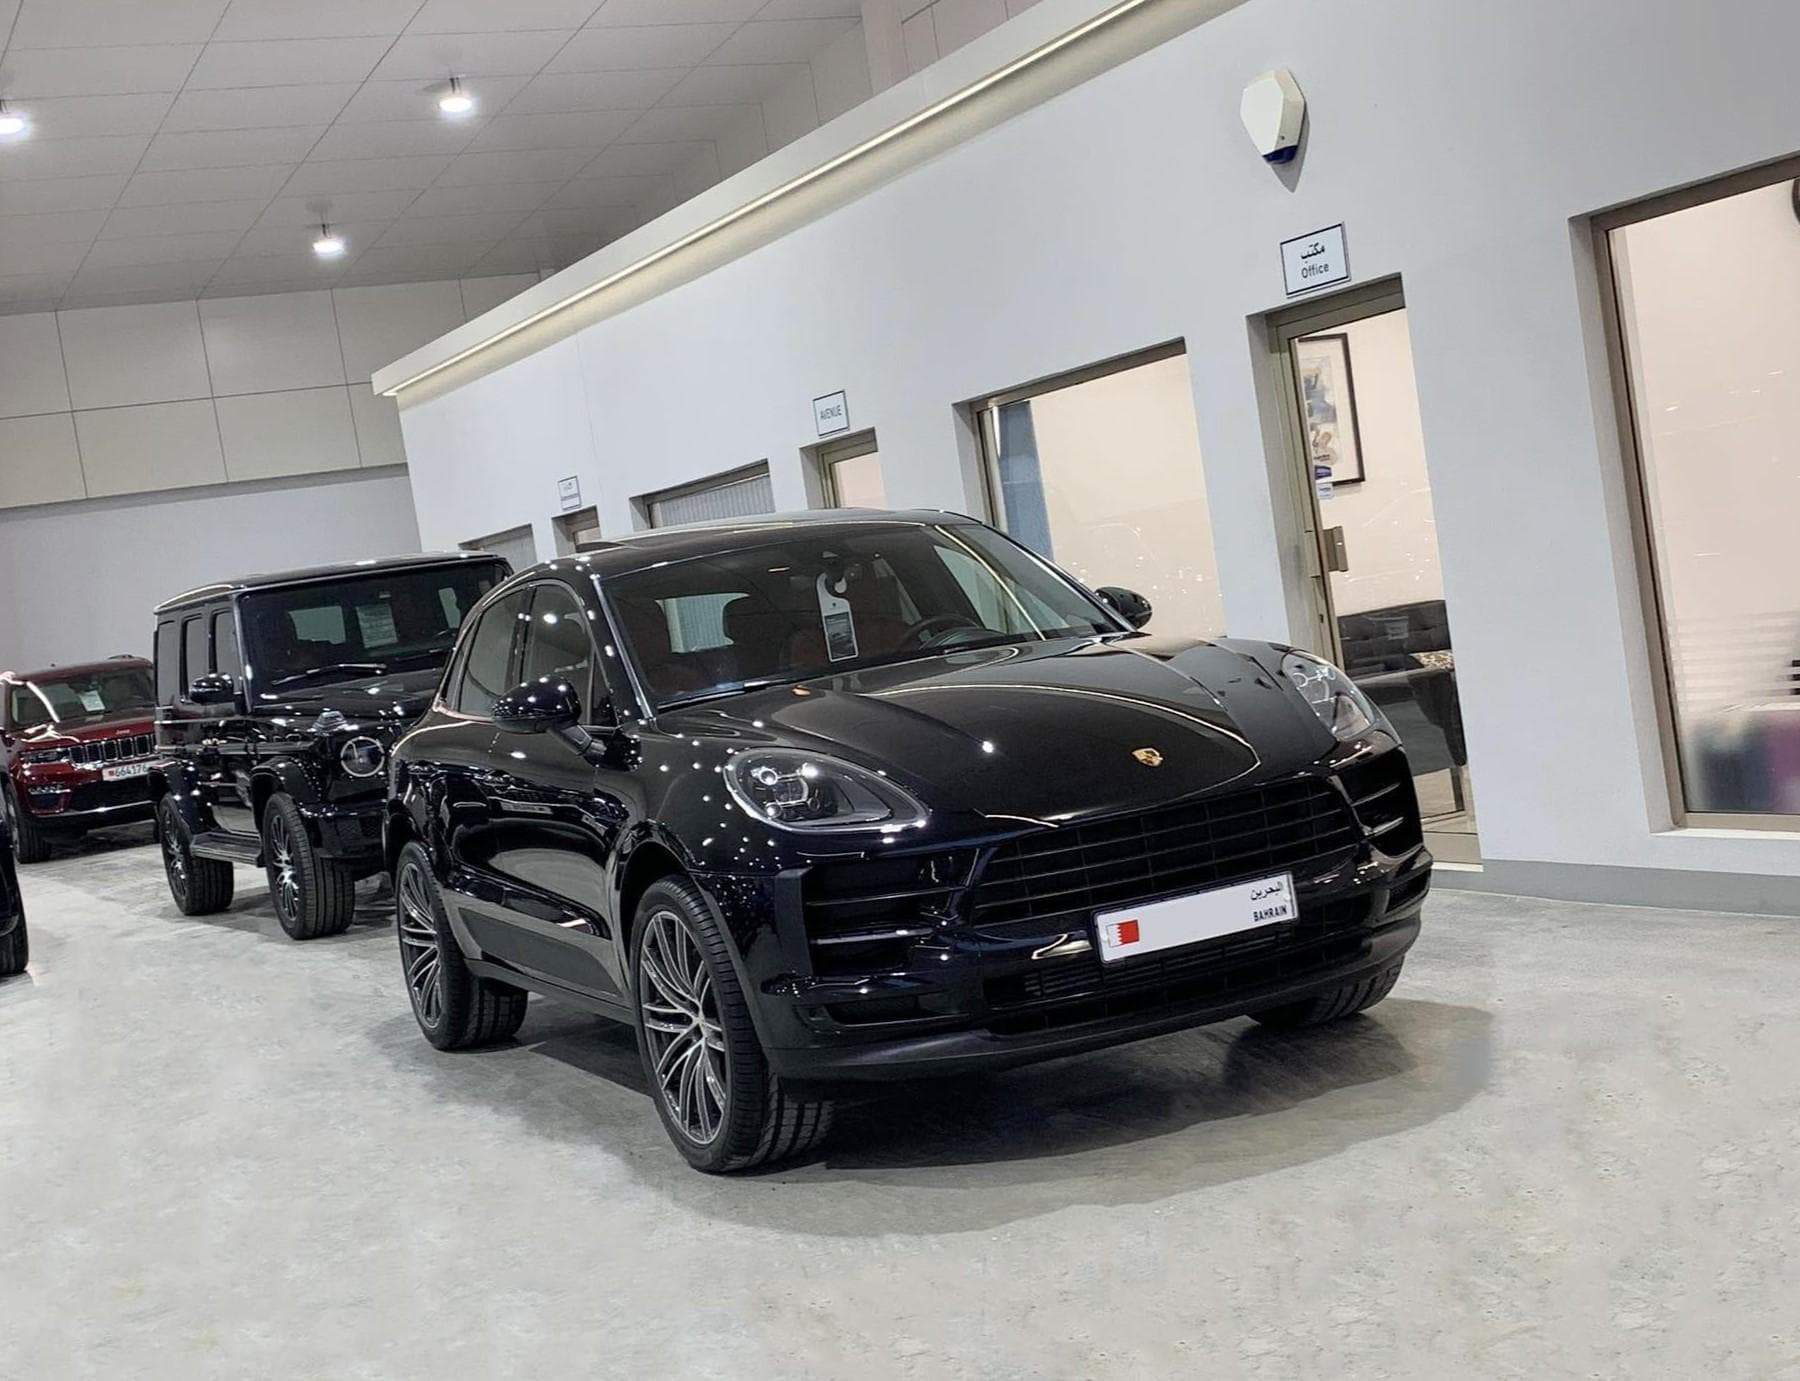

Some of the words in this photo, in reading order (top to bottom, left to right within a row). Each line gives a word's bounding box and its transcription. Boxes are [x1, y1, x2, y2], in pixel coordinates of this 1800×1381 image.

[1301, 242, 1325, 264] مكتب
[1301, 264, 1329, 279] Office
[1250, 881, 1283, 901] البحرين
[1253, 904, 1287, 922] BAHRAIN
